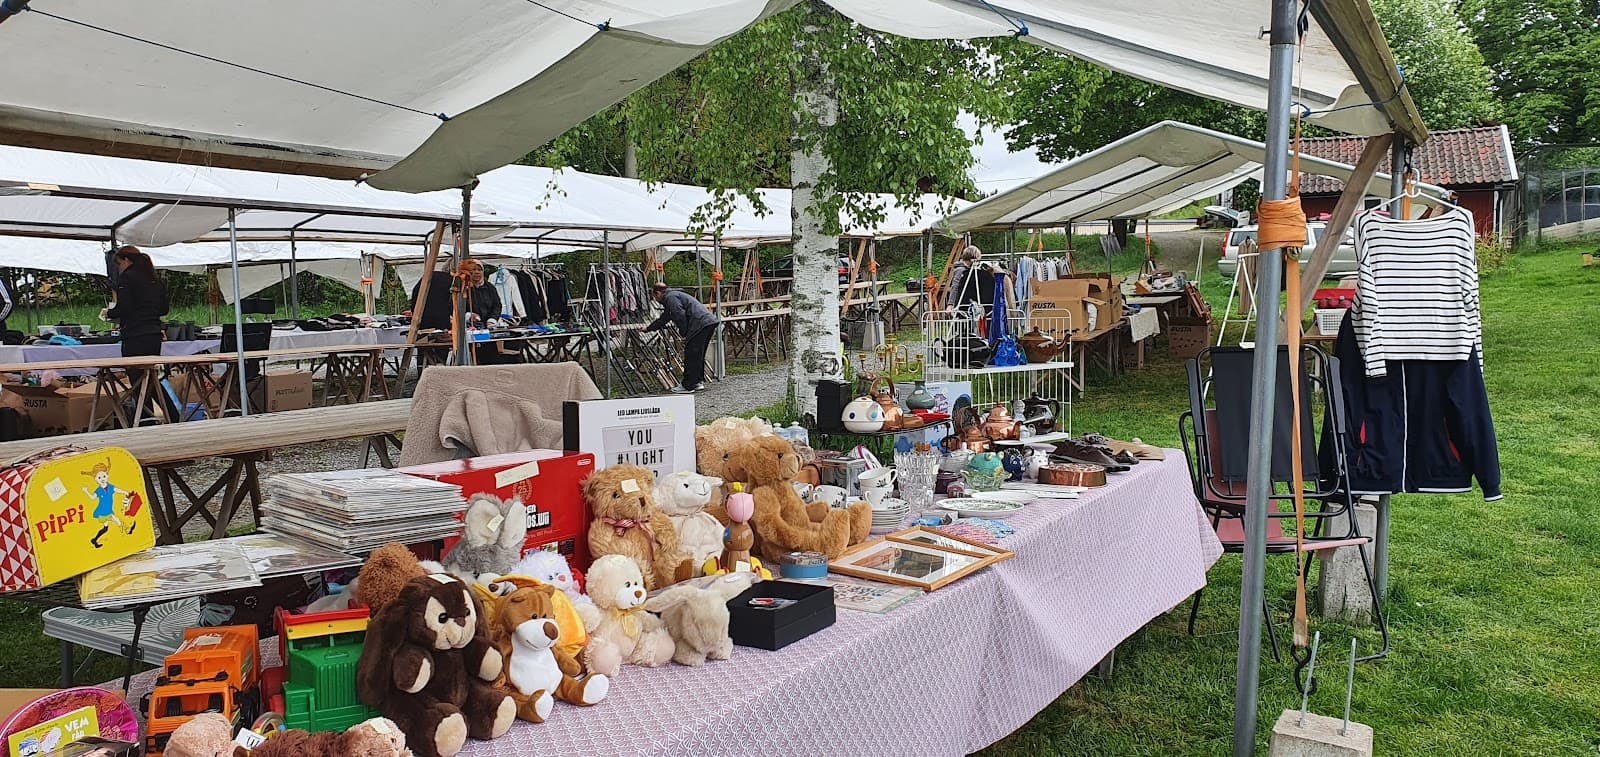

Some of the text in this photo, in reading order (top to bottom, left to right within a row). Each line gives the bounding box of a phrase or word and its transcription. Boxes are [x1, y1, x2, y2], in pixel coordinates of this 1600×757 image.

[24, 399, 48, 408] RUSTA
[628, 428, 652, 446] YOU
[64, 716, 89, 733] VEM
